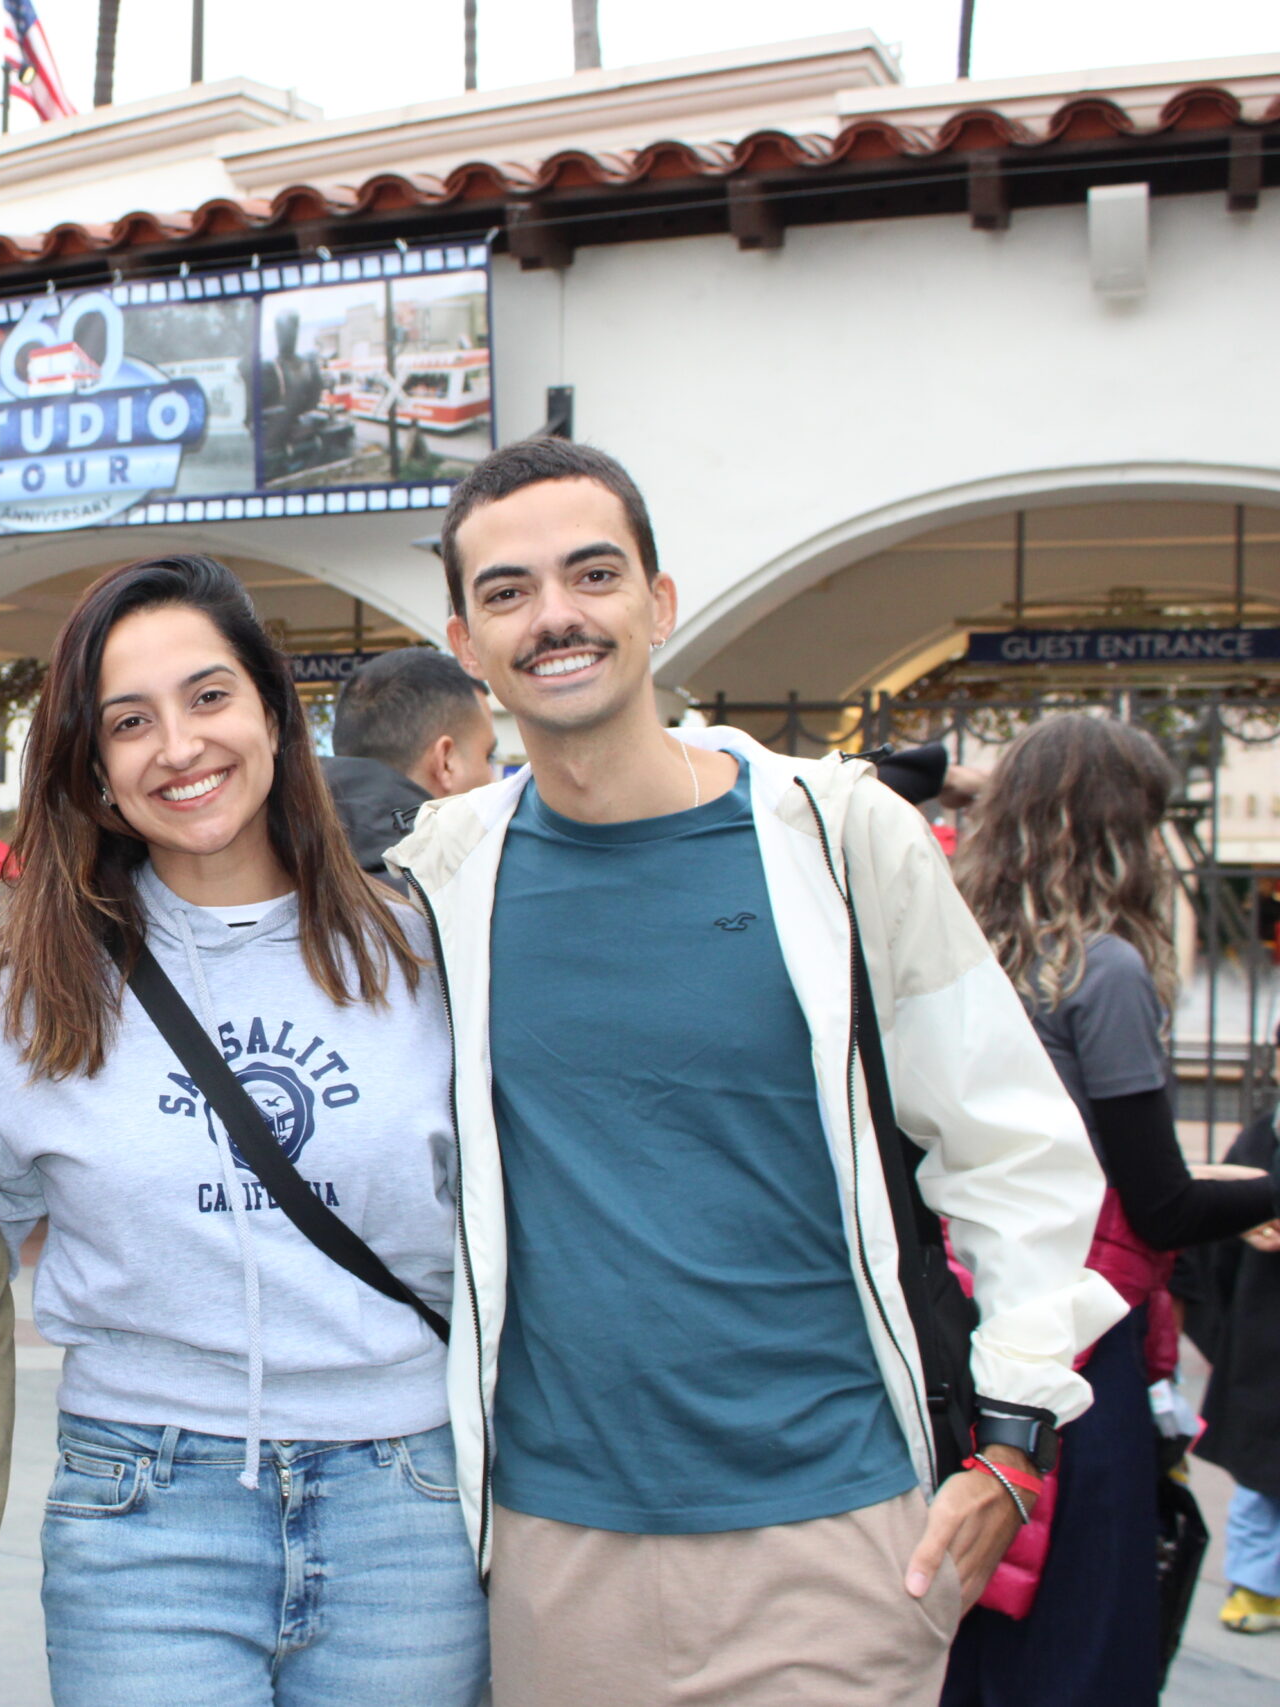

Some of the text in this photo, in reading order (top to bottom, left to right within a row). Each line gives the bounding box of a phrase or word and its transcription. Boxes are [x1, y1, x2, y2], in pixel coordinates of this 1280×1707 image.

[0, 496, 113, 523] ANNIVERSARY
[1000, 633, 1254, 660] GUEST ENTRANCE
[159, 1016, 360, 1118] SASALITO
[198, 1181, 340, 1213] CAIFIA
